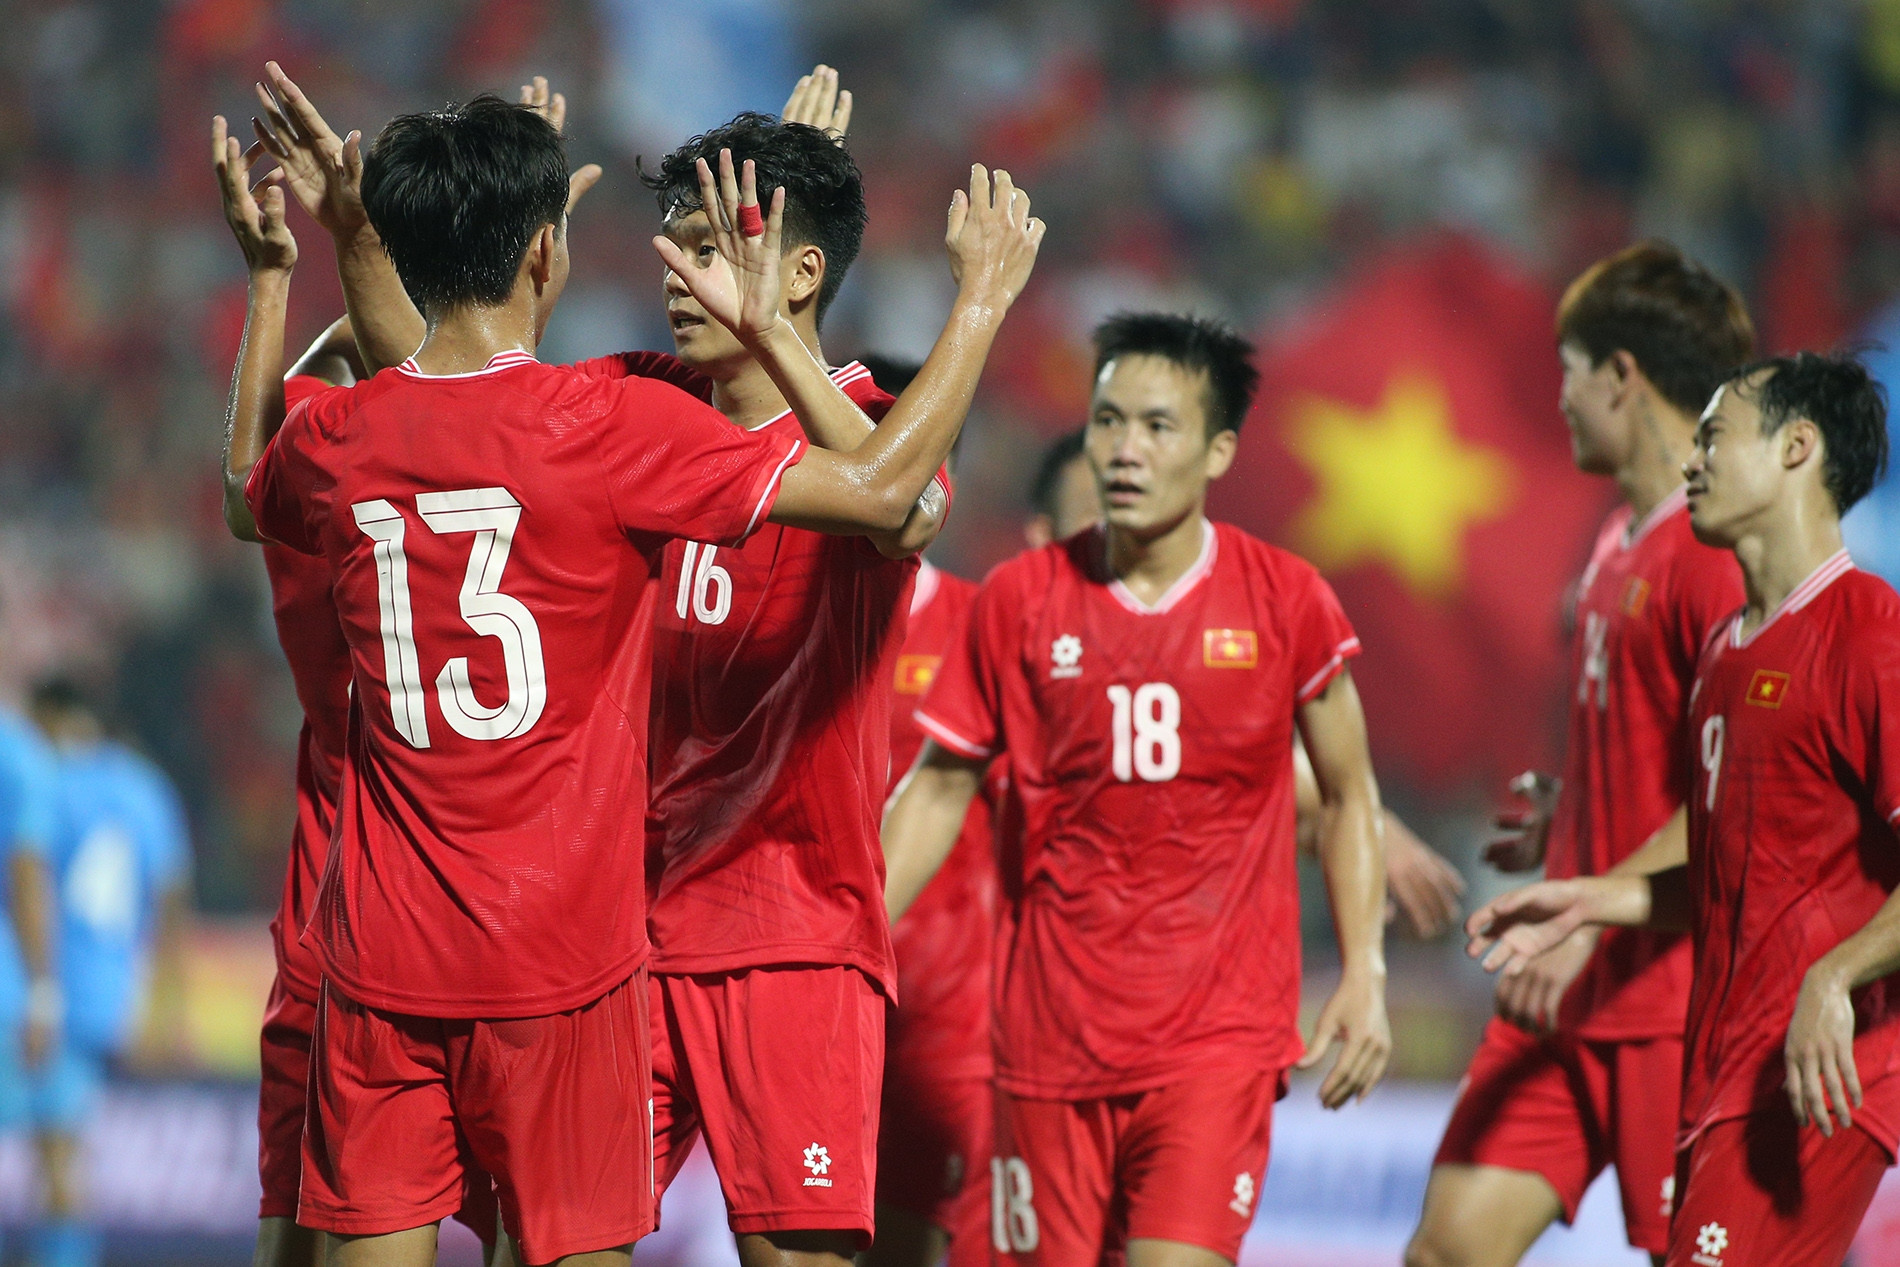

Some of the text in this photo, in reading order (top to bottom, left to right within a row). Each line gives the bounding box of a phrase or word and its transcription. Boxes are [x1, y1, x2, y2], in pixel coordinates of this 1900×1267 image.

[351, 486, 547, 749] 13
[675, 540, 733, 625] 16
[1106, 681, 1182, 783] 18
[1701, 713, 1725, 813] 9
[990, 1155, 1041, 1254] 18
